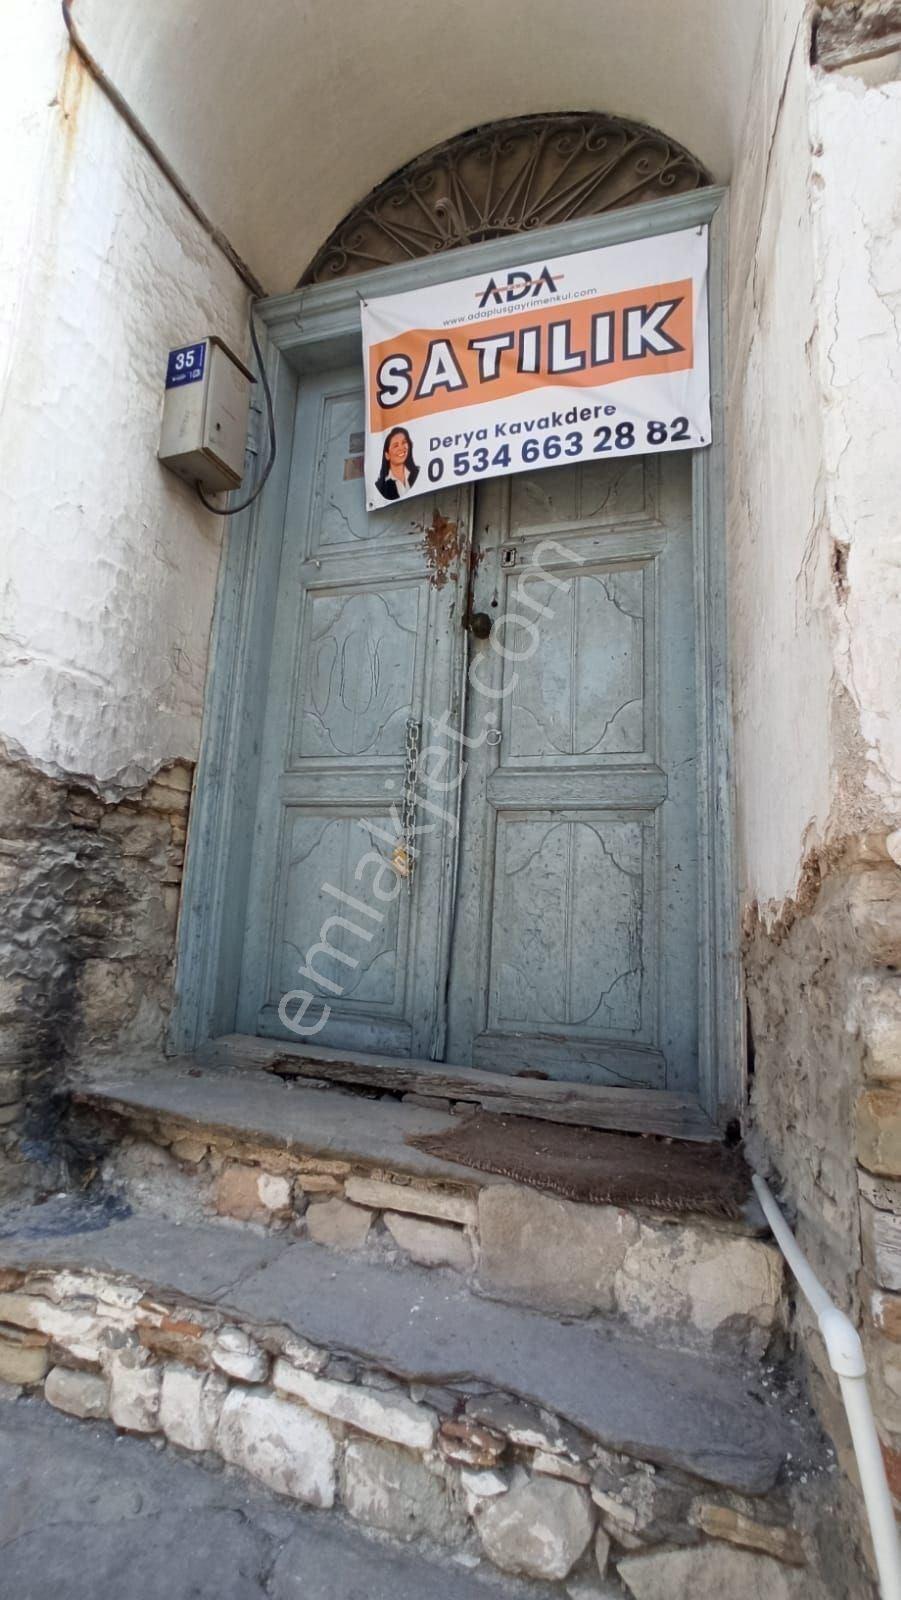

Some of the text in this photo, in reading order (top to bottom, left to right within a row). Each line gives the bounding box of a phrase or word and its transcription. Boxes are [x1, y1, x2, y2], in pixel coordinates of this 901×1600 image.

[443, 287, 598, 326] www.adaplusgayrimenkul.com
[478, 265, 558, 309] ADA
[175, 350, 195, 370] 35
[375, 296, 686, 410] SATILIK
[427, 416, 692, 482] 0 534 663 28 82
[429, 404, 617, 451] Derya Kavakdere
